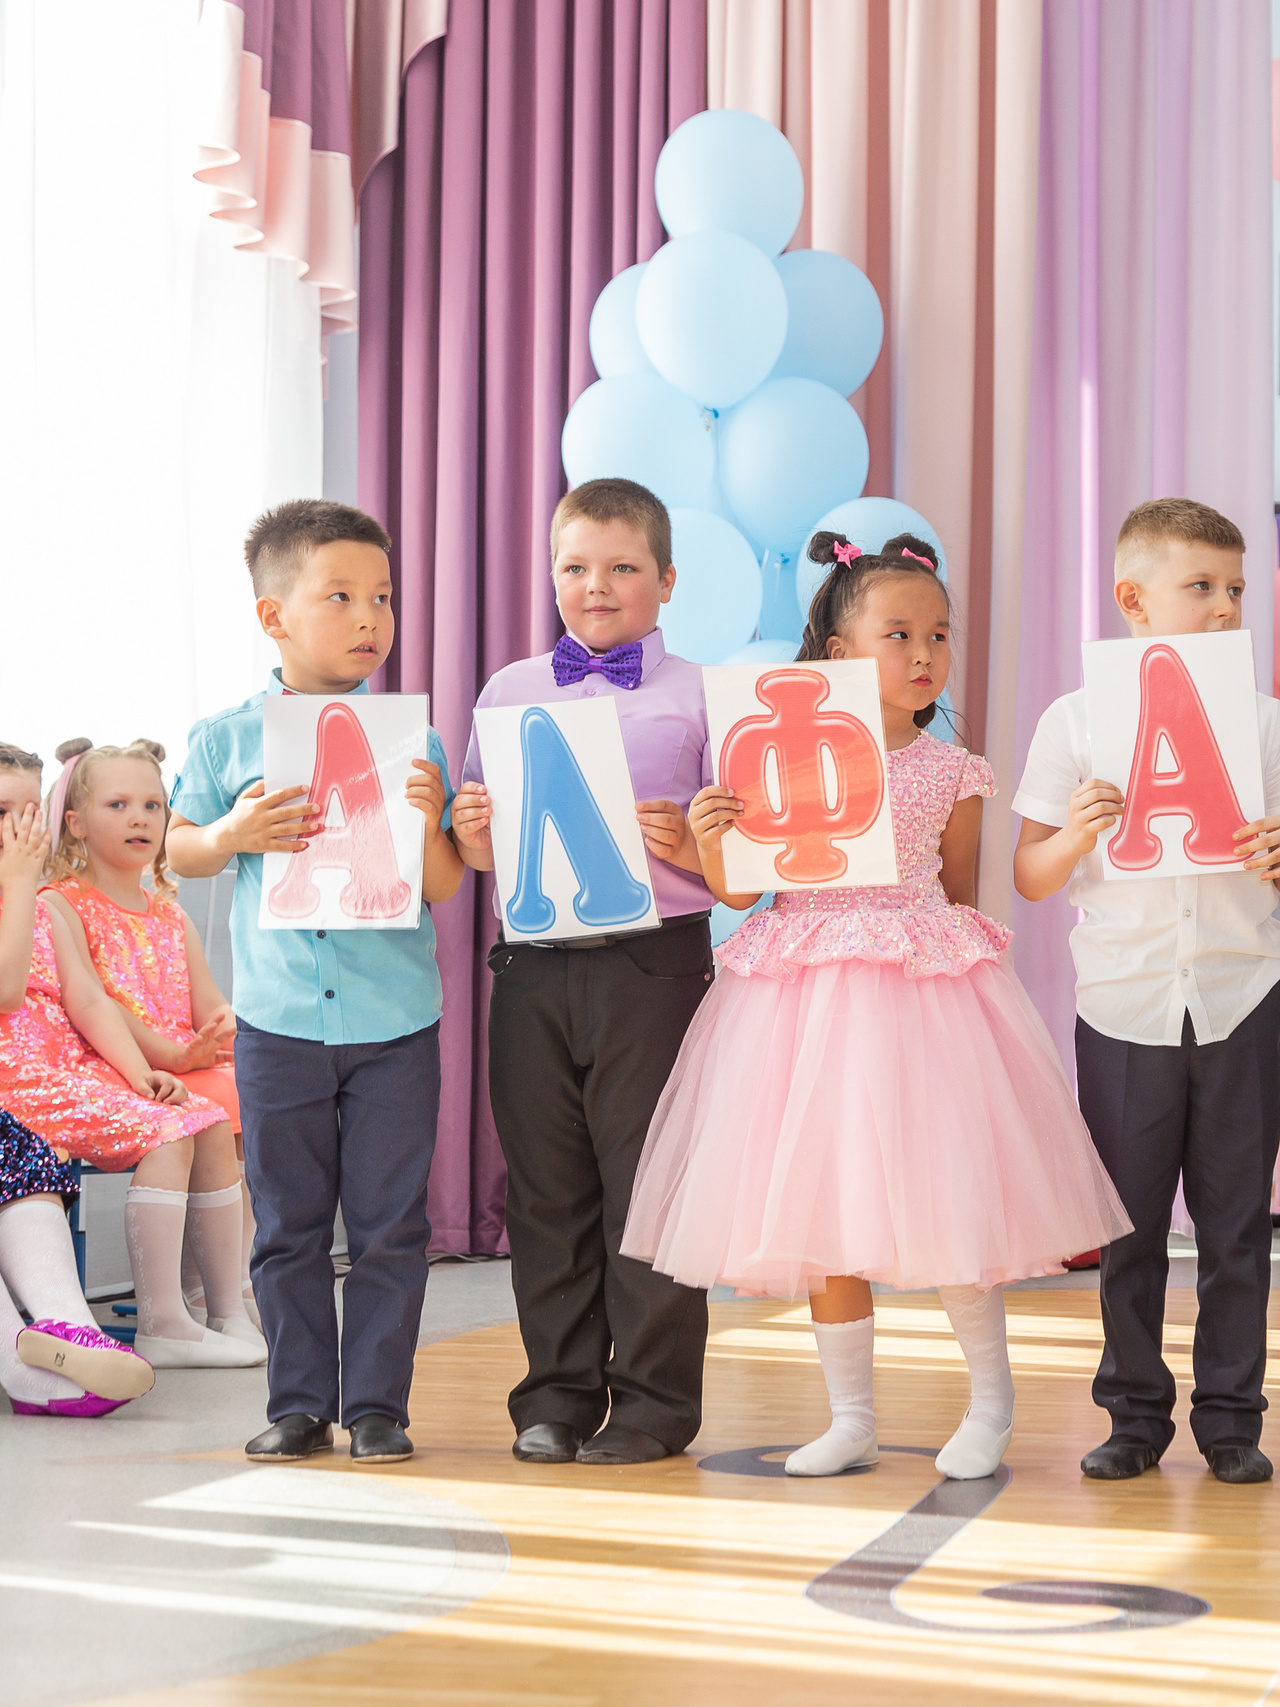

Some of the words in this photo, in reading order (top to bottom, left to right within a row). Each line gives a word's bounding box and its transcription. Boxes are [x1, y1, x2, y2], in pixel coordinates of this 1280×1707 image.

[268, 702, 411, 919] А
[506, 706, 651, 934] Л
[718, 668, 884, 884] Ф
[1108, 643, 1258, 871] А
